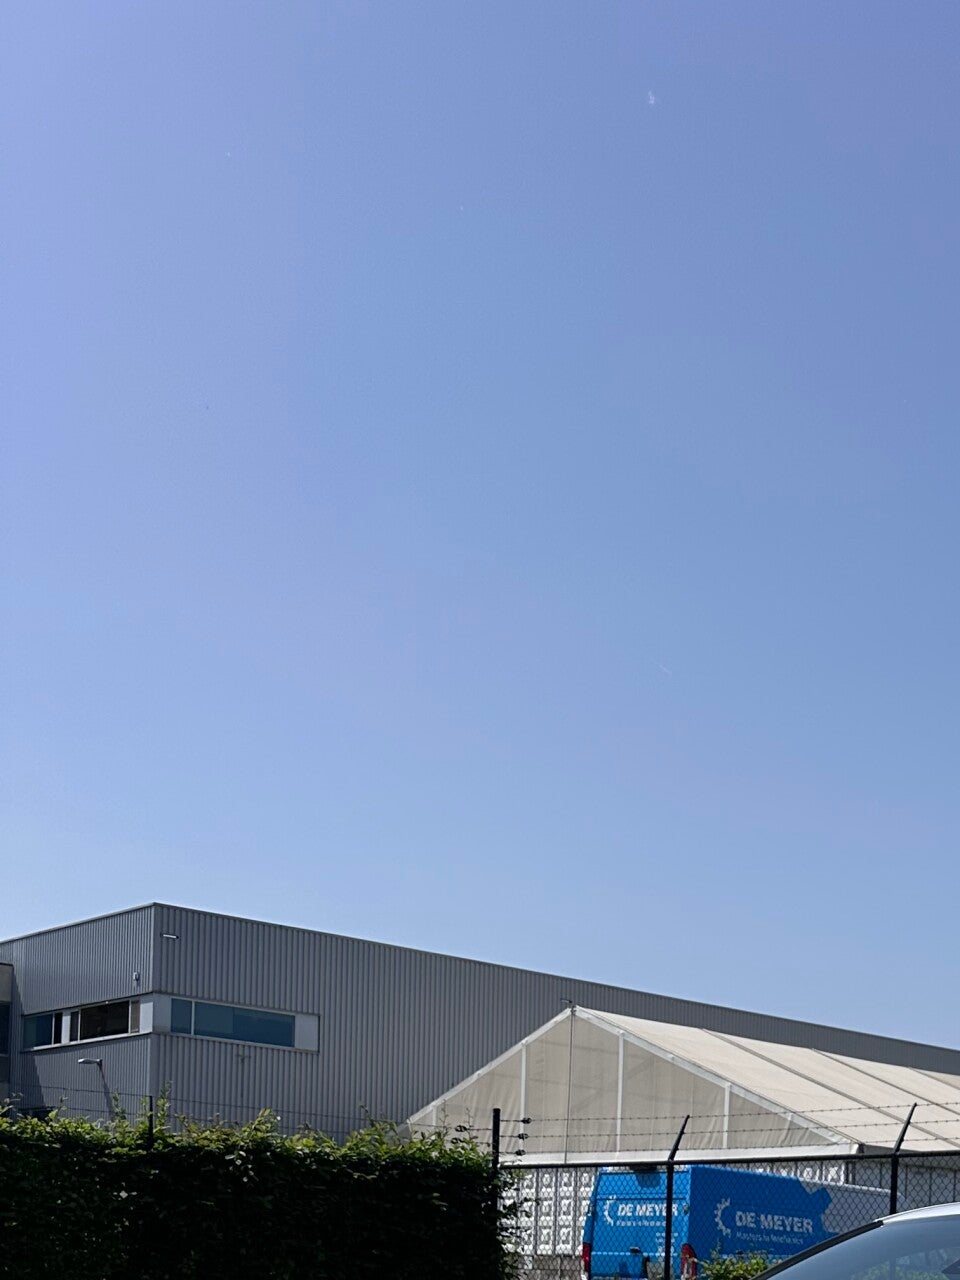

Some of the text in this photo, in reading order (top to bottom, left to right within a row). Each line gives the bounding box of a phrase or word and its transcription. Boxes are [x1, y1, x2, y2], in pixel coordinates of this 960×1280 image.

[617, 1203, 634, 1216] DE
[735, 1210, 813, 1233] DE MEYER
